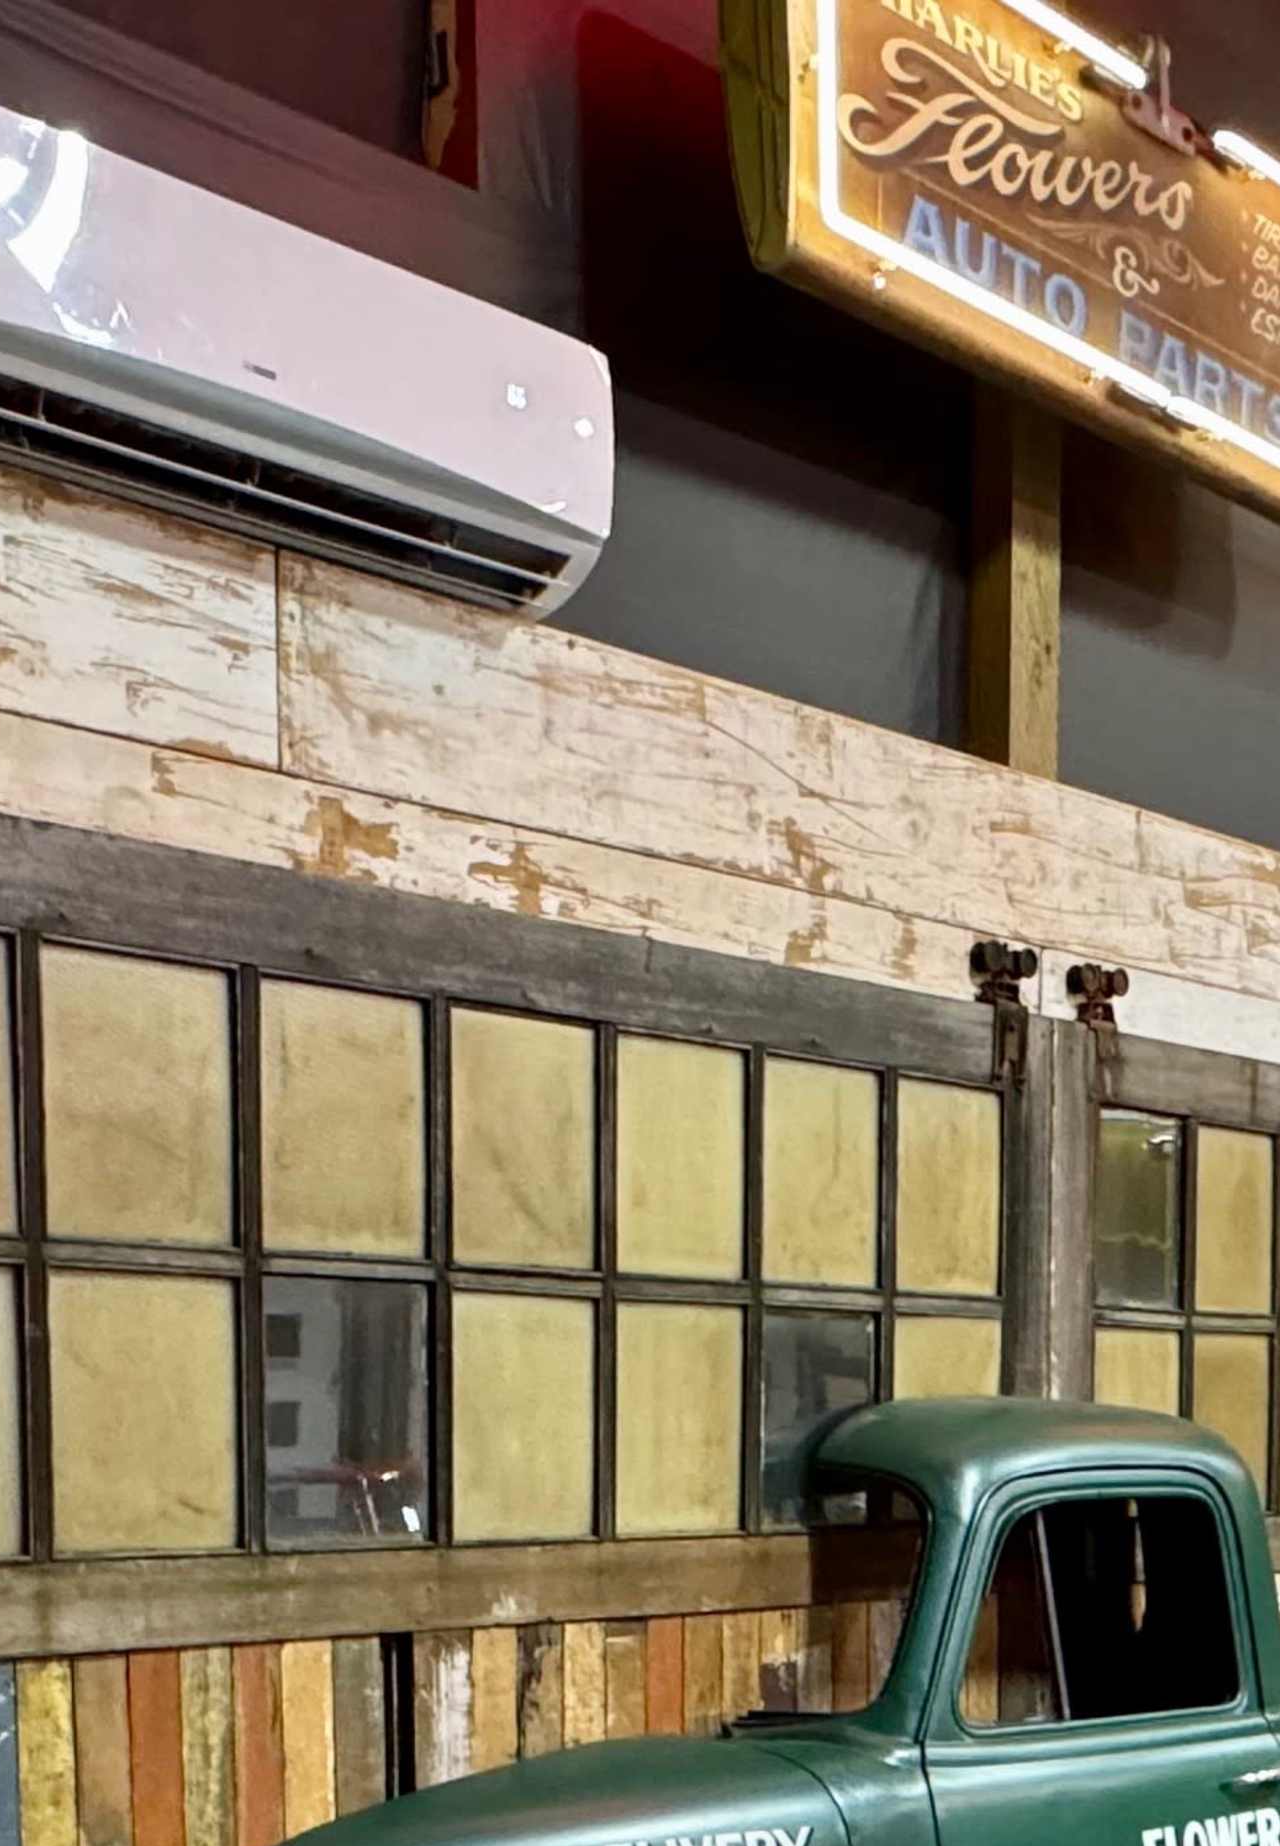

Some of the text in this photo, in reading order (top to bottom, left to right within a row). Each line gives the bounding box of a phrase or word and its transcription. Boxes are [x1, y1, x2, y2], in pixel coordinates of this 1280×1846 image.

[837, 38, 1193, 231] Flowers
[902, 193, 1089, 342] AUTO
[1112, 246, 1160, 298] &
